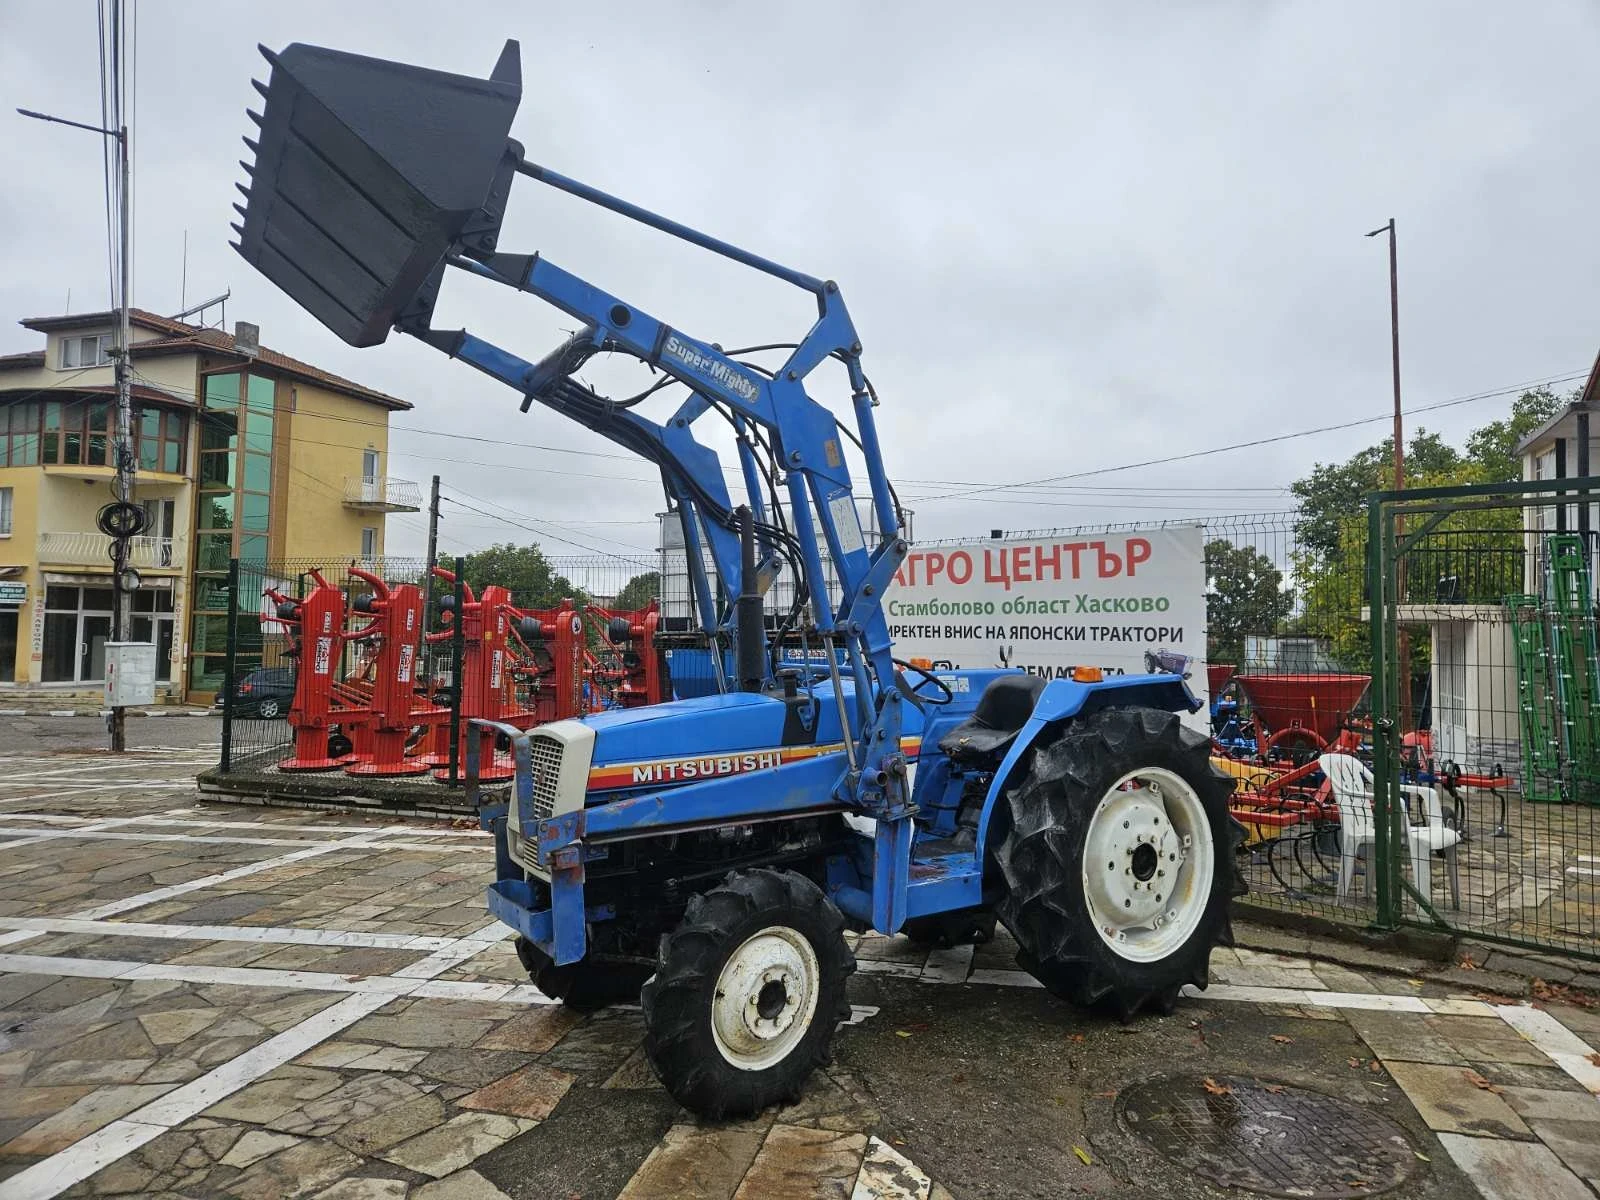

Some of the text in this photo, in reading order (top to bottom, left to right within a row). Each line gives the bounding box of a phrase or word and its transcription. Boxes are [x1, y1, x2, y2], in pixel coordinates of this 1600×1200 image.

[666, 336, 757, 399] Super Mighty
[984, 538, 1152, 591] ЦЕНТЪР
[888, 594, 1170, 617] Стамболово област Хасково
[944, 625, 982, 639] ВНИС
[986, 625, 1006, 639] НА
[1009, 625, 1086, 642] ЯПОНСКИ
[1090, 626, 1183, 643] ТРАКТОРИ
[632, 752, 782, 783] MITSUBISHI
